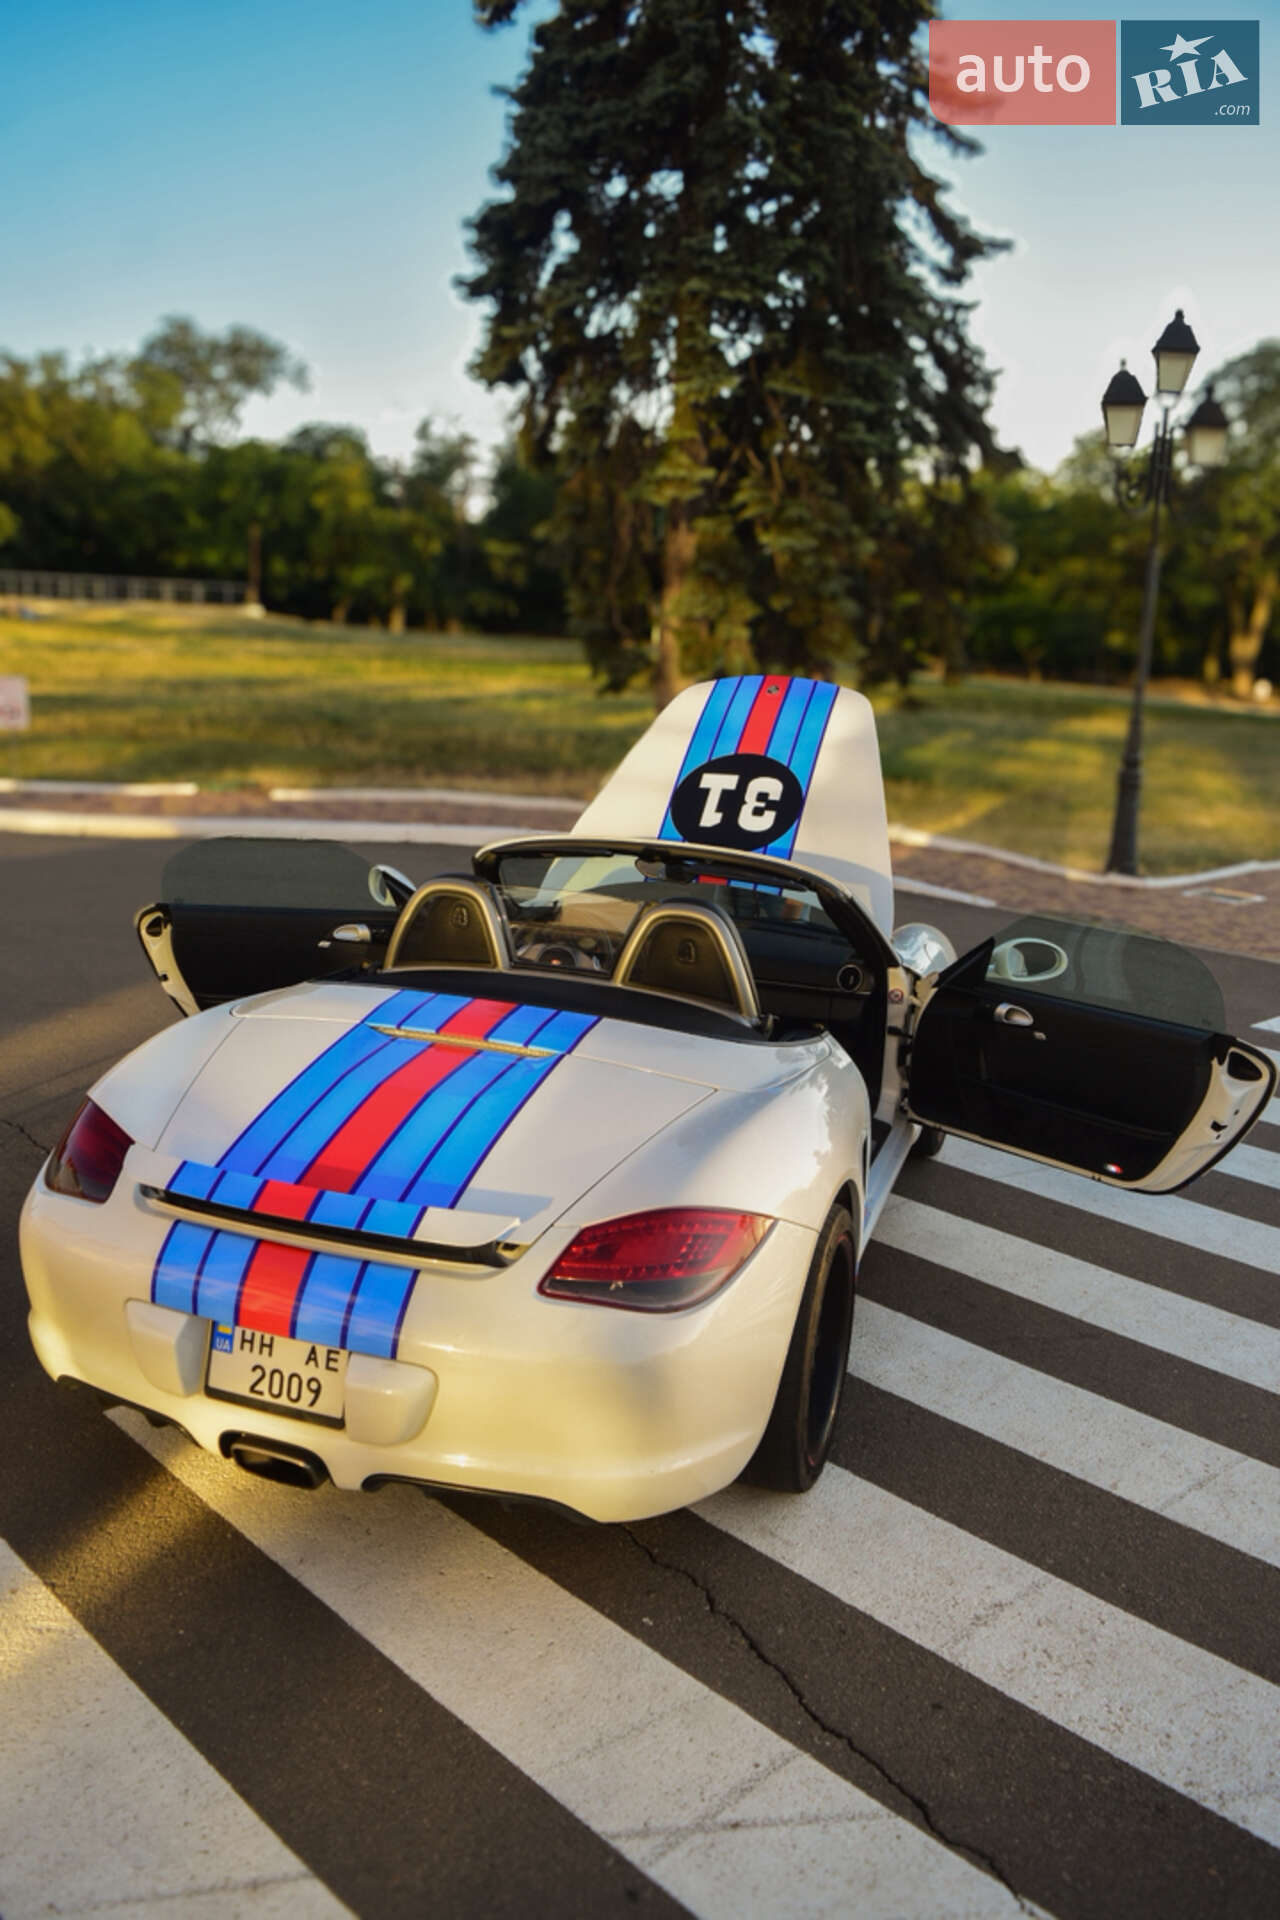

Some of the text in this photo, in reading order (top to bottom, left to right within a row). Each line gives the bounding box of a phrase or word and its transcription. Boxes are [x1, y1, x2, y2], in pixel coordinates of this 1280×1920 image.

[698, 772, 784, 832] 31
[216, 1336, 231, 1350] UA
[240, 1329, 340, 1372] HH AE
[249, 1364, 322, 1407] 2009
